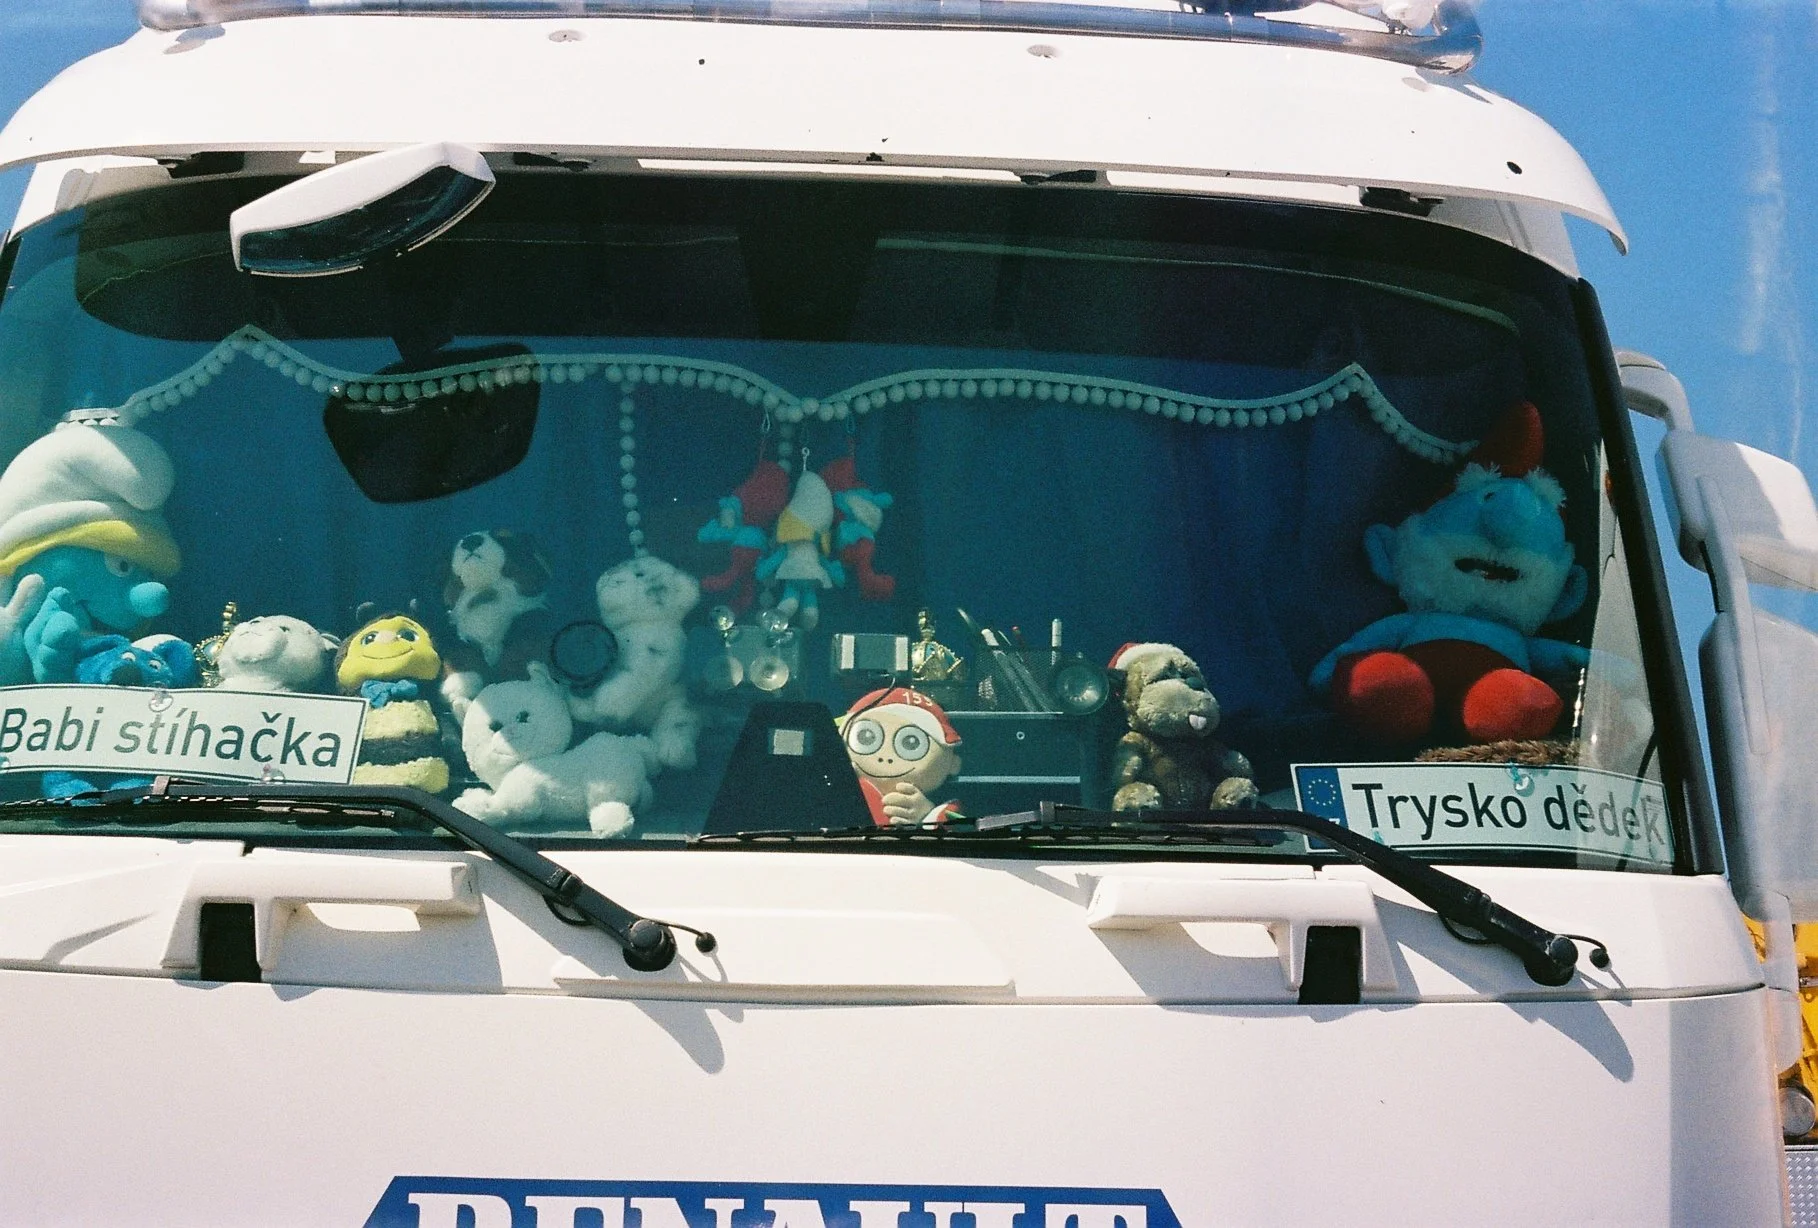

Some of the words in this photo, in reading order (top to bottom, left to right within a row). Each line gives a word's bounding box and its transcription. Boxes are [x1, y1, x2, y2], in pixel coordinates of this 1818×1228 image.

[0, 706, 104, 754] Babi
[113, 706, 342, 768] stíhačka
[1351, 782, 1527, 841] Trysko
[1543, 782, 1665, 845] dědek
